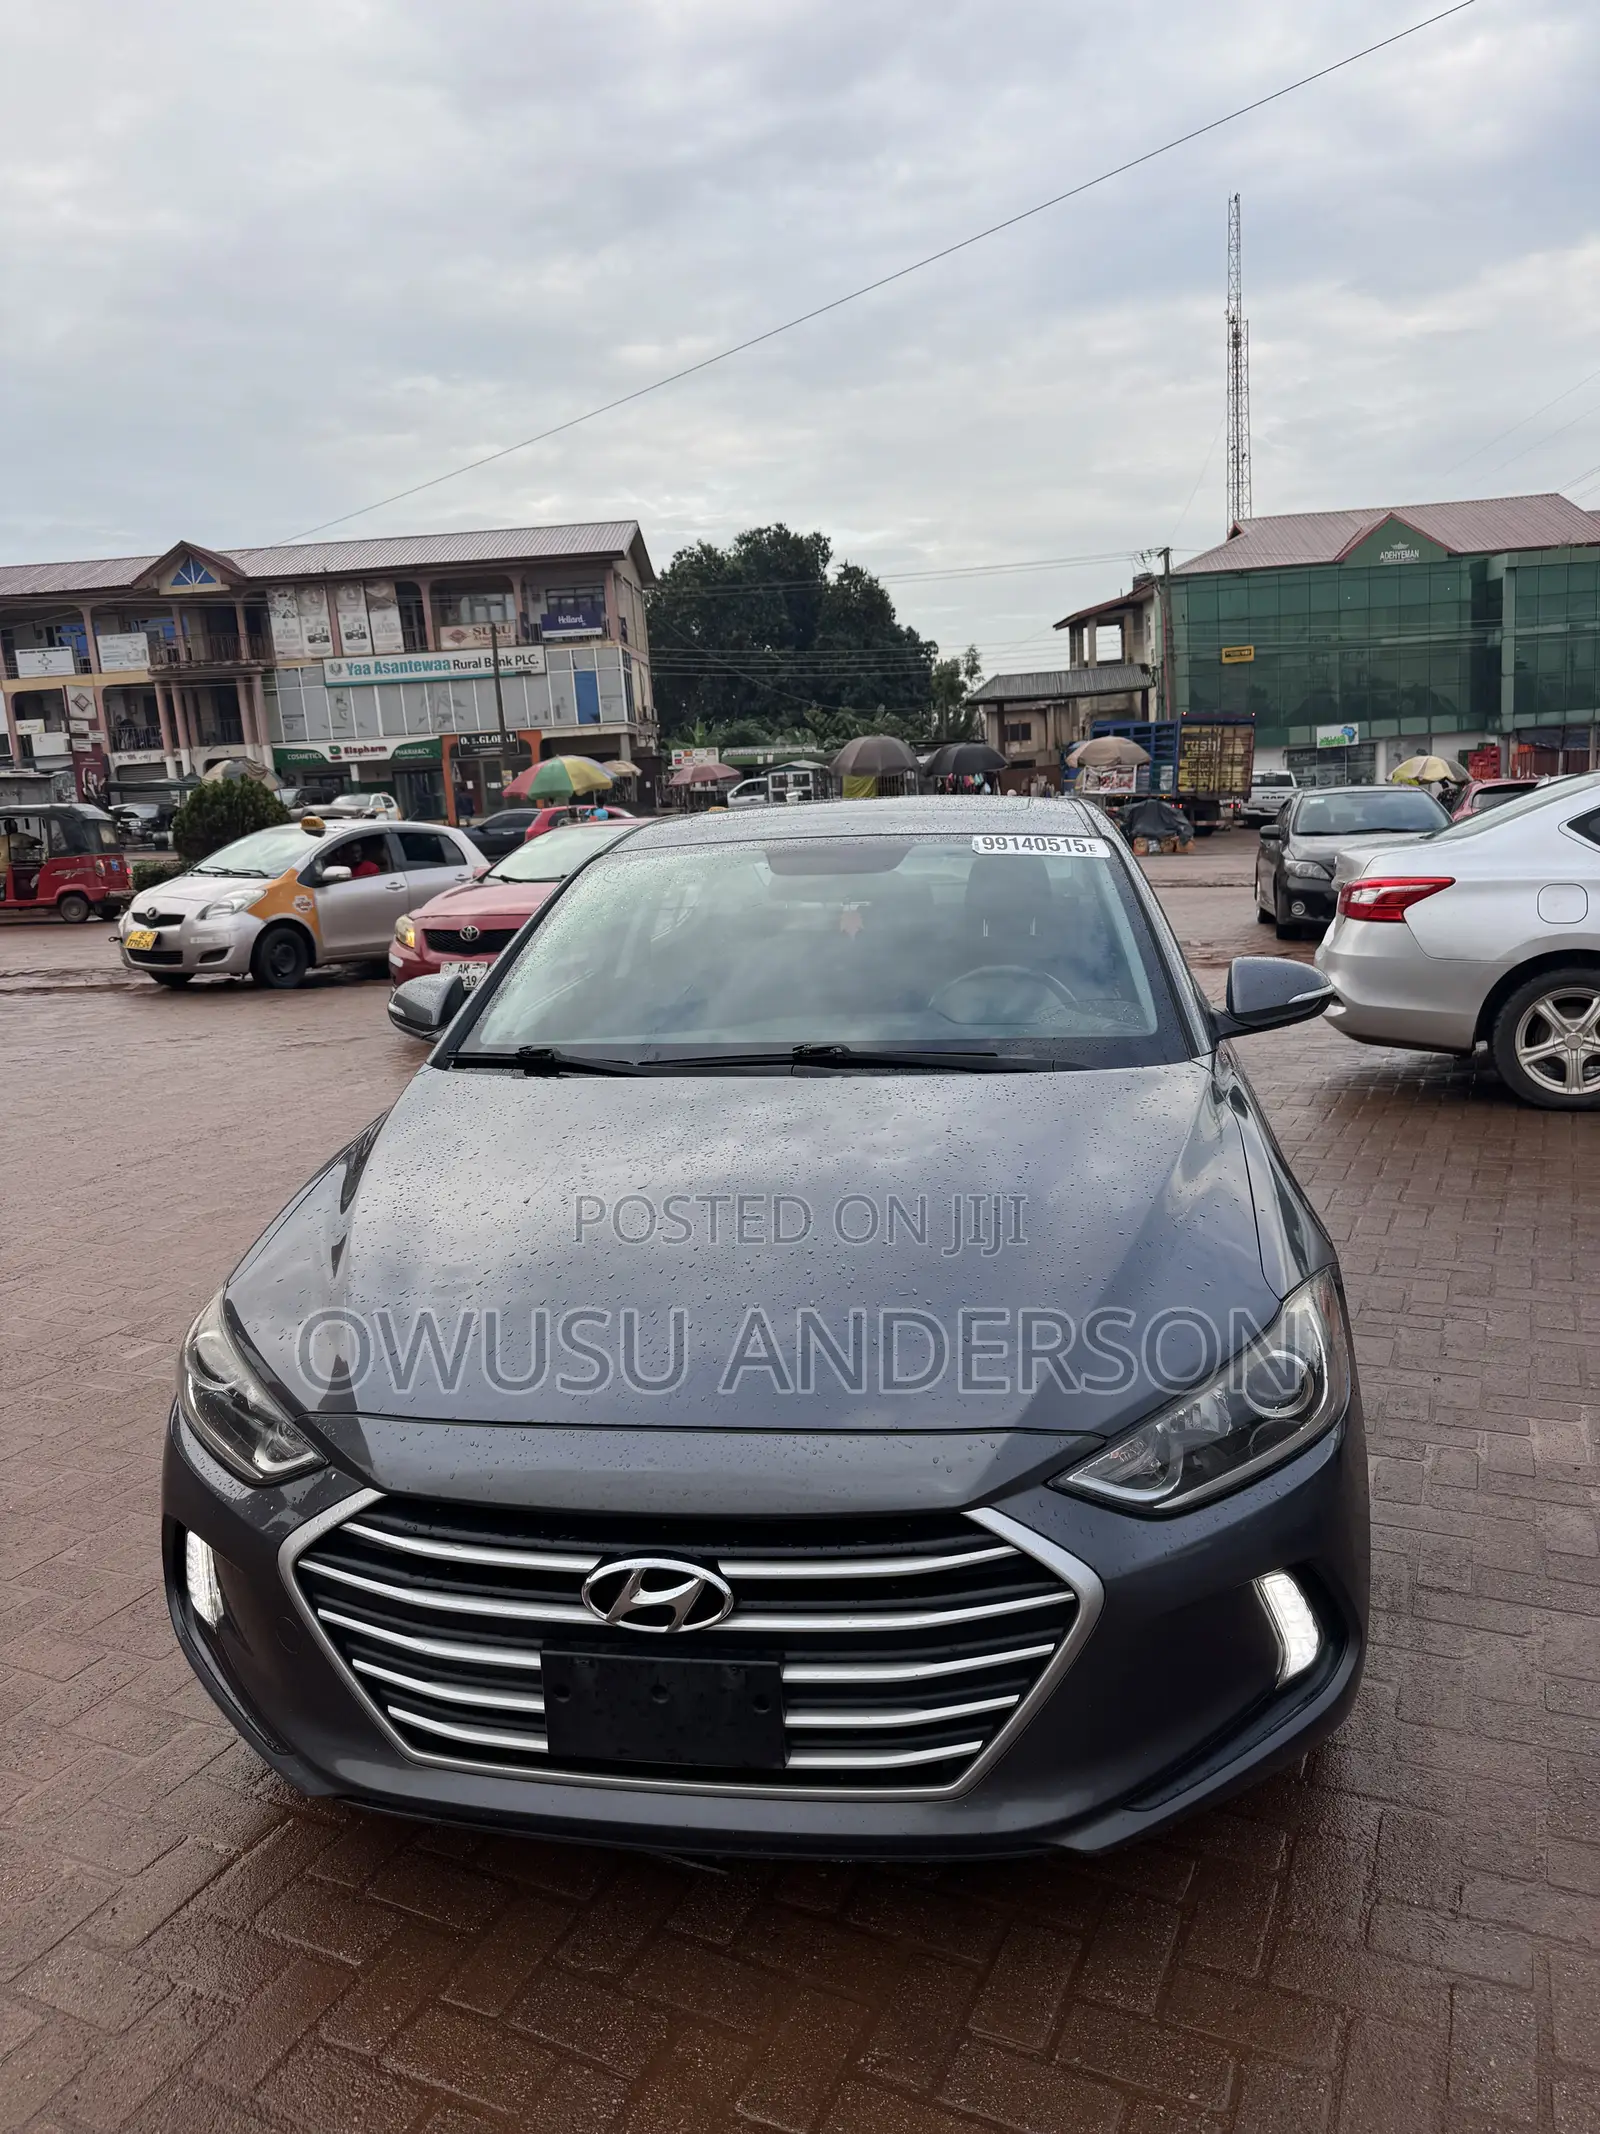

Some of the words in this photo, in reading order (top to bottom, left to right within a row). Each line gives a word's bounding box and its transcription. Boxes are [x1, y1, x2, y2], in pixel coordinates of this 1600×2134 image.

[1380, 549, 1420, 560] ADEHYEMAN
[346, 662, 371, 676] Yaa
[374, 659, 451, 675] Asantewaa
[453, 657, 482, 670] Rural
[515, 654, 540, 666] PLC.
[287, 752, 323, 760] COSMETICS
[394, 748, 430, 756] PHARMACY
